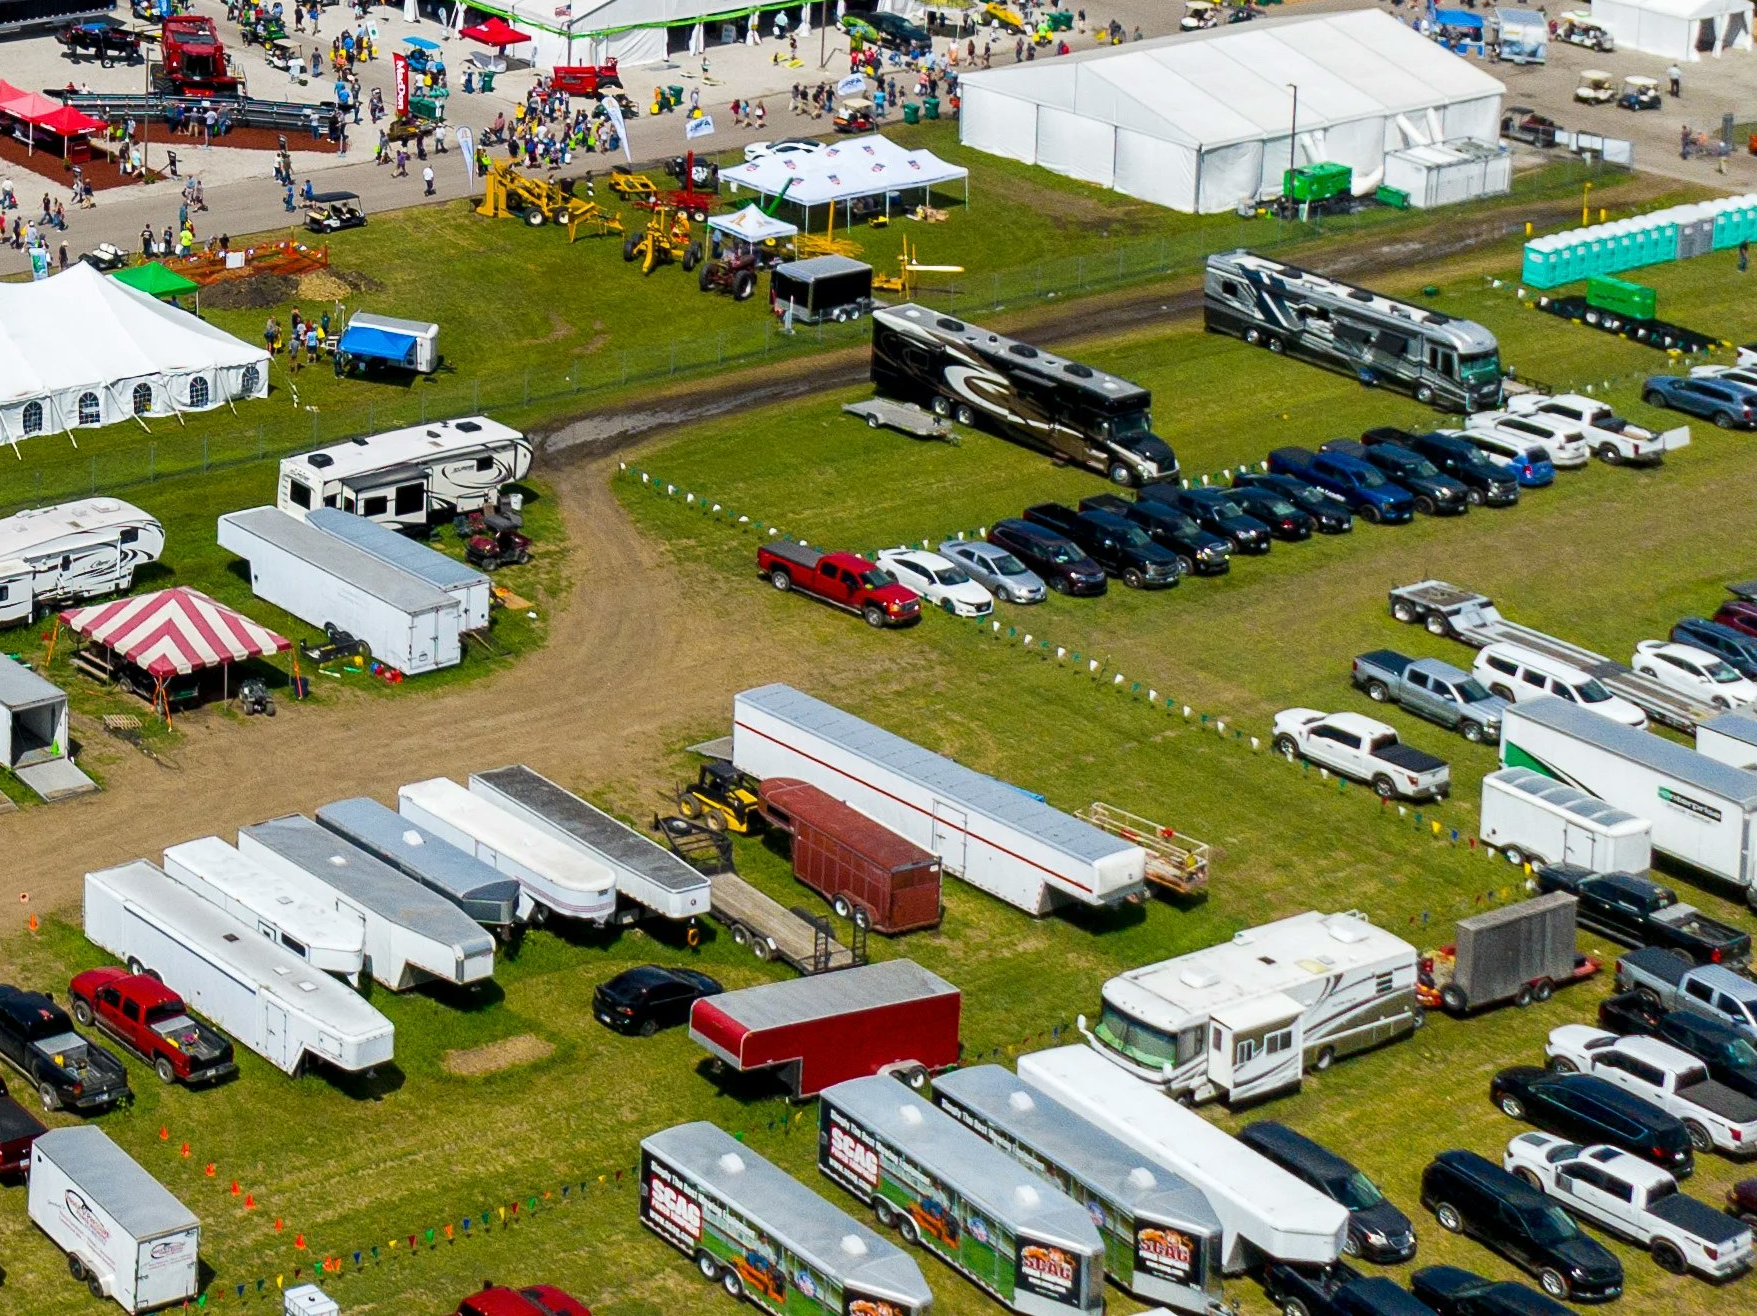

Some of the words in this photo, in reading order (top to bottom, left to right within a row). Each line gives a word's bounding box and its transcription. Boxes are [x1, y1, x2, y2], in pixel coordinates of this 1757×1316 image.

[396, 59, 406, 110] MacDon
[831, 1127, 878, 1175] SCAG
[651, 1178, 702, 1228] SCAG
[682, 1177, 698, 1198] Best
[1022, 1255, 1073, 1281] SCAG
[1139, 1238, 1190, 1264] SCAG
